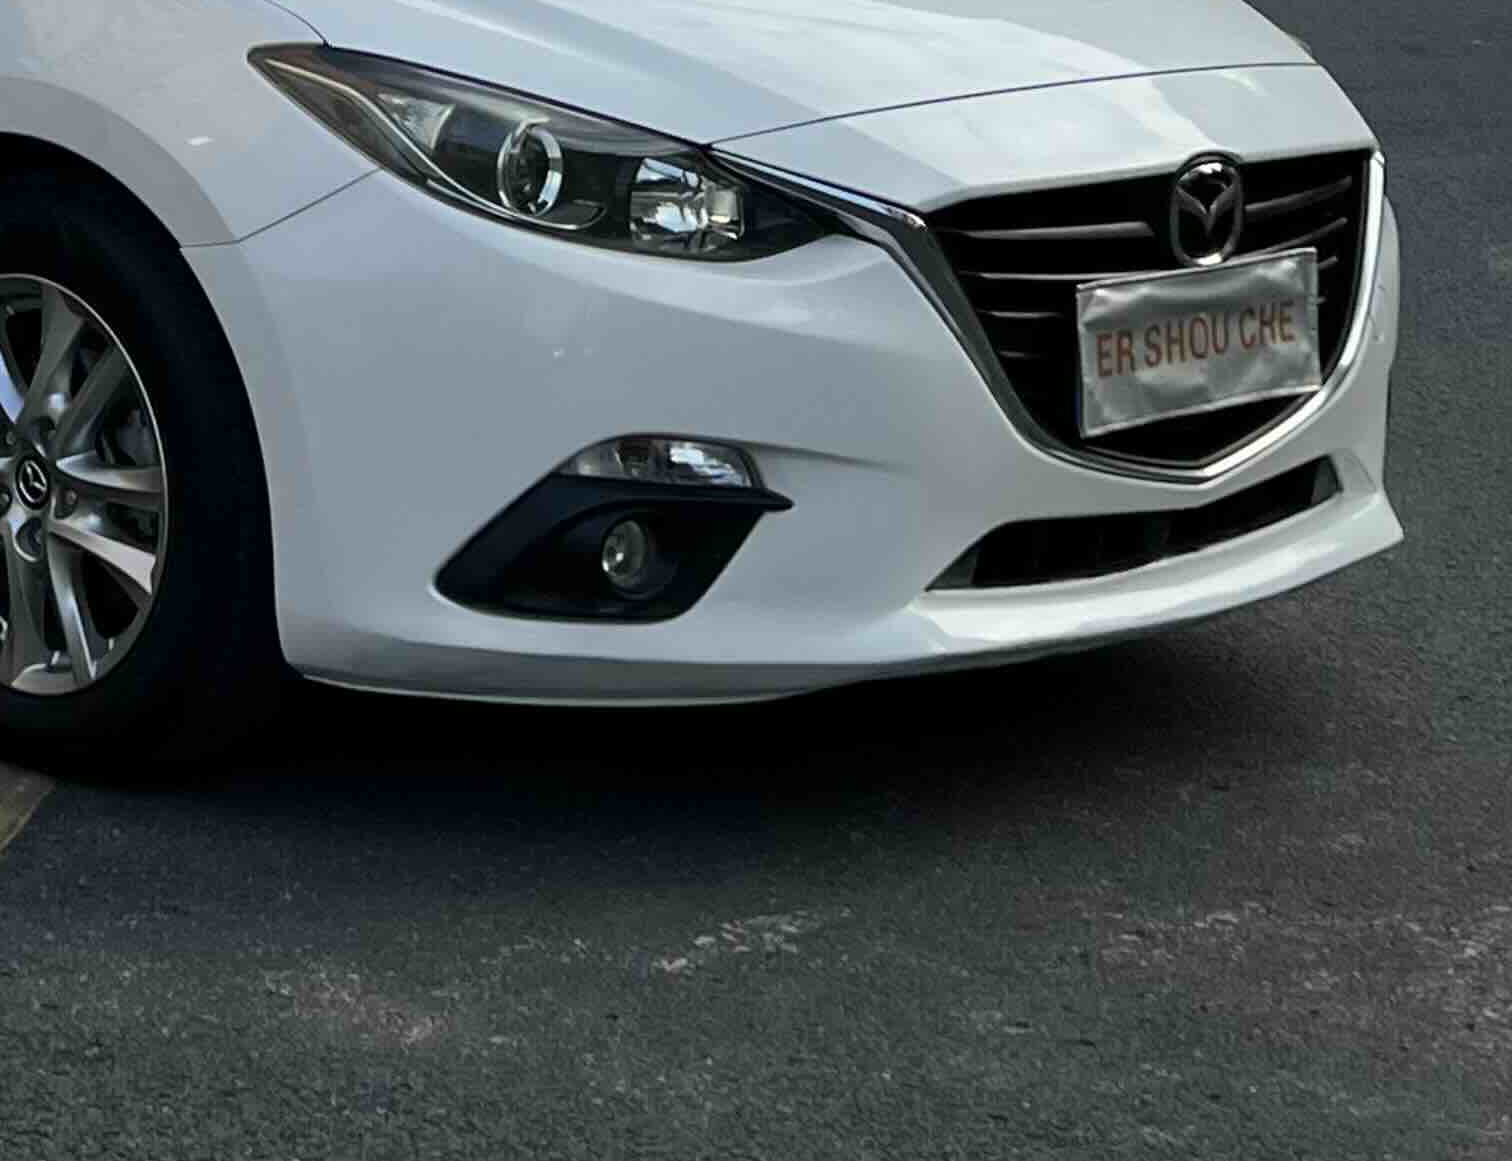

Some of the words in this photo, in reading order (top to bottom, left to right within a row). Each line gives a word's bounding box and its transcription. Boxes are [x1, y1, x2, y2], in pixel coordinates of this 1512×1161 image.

[1095, 328, 1136, 378] ER
[1143, 311, 1229, 367] SHOU
[1239, 299, 1295, 350] CHE
